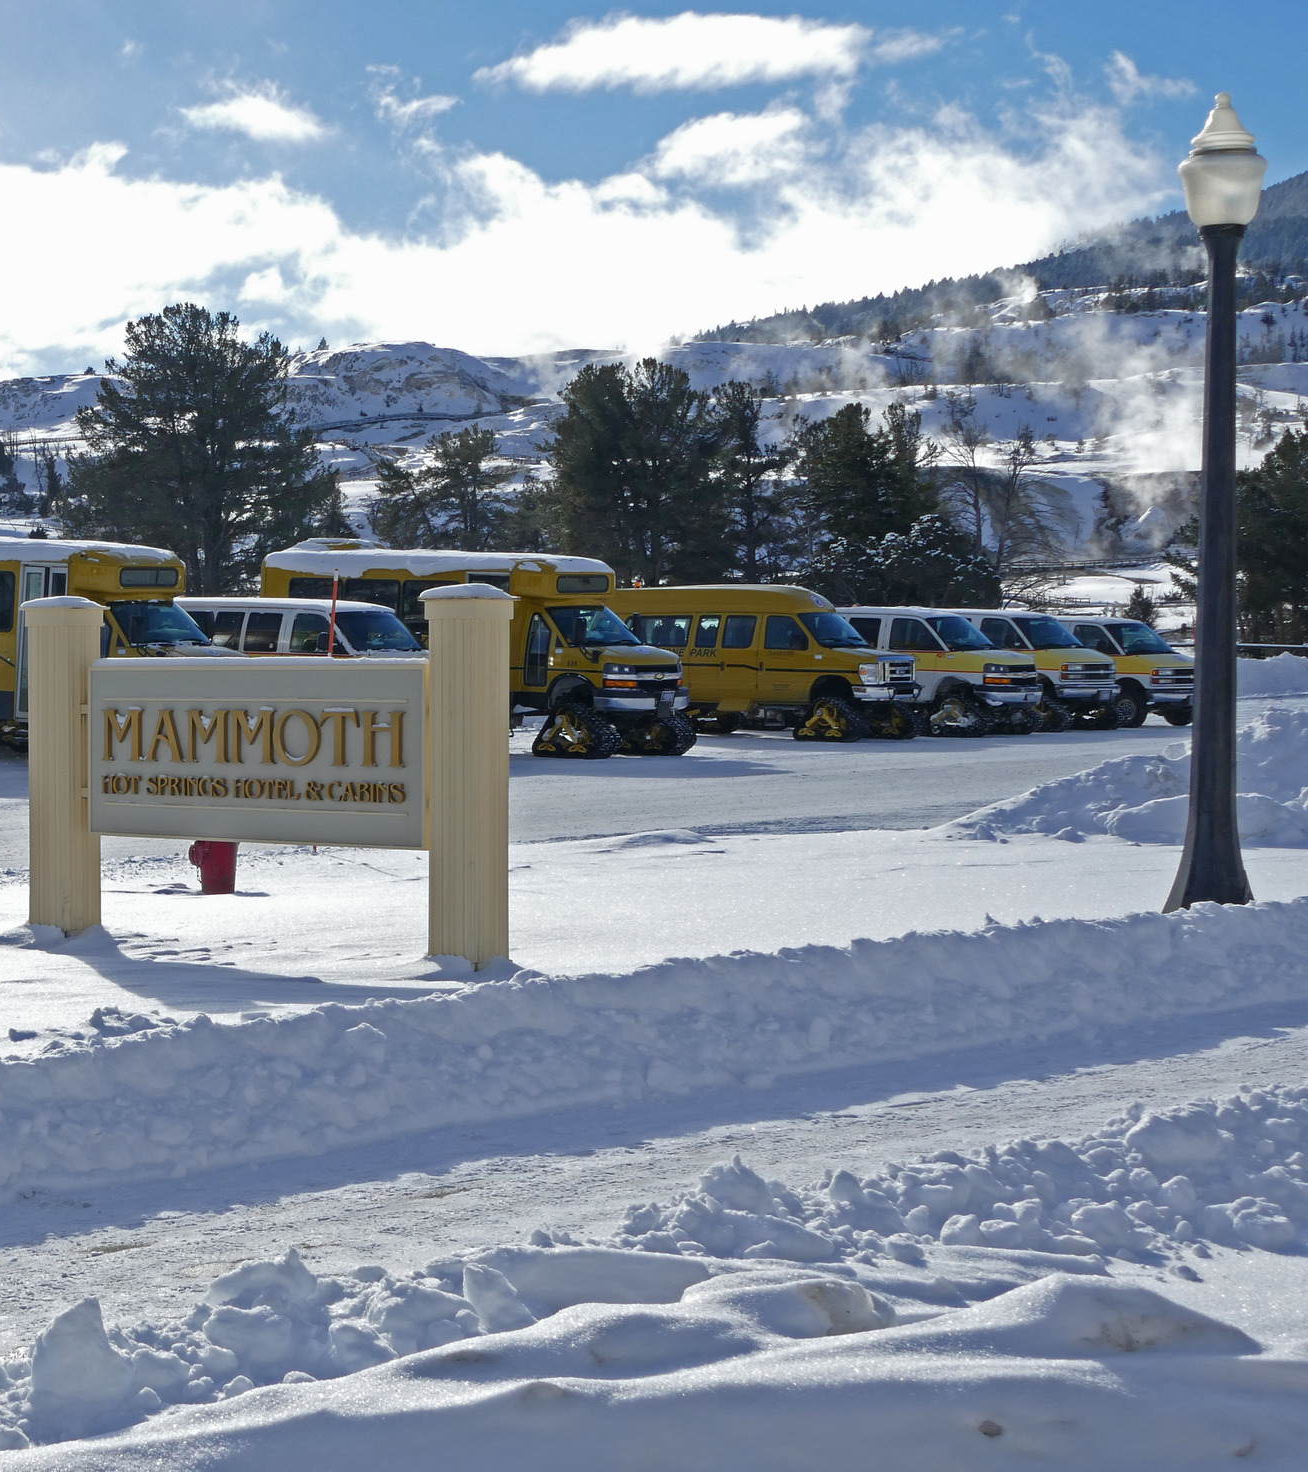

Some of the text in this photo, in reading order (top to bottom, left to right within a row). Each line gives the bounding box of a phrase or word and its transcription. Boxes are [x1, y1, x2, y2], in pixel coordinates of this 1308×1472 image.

[689, 648, 717, 658] PARK
[101, 706, 407, 768] MAMMOTH
[101, 774, 407, 804] HOT SPRINGS HOTEL & CABINS
